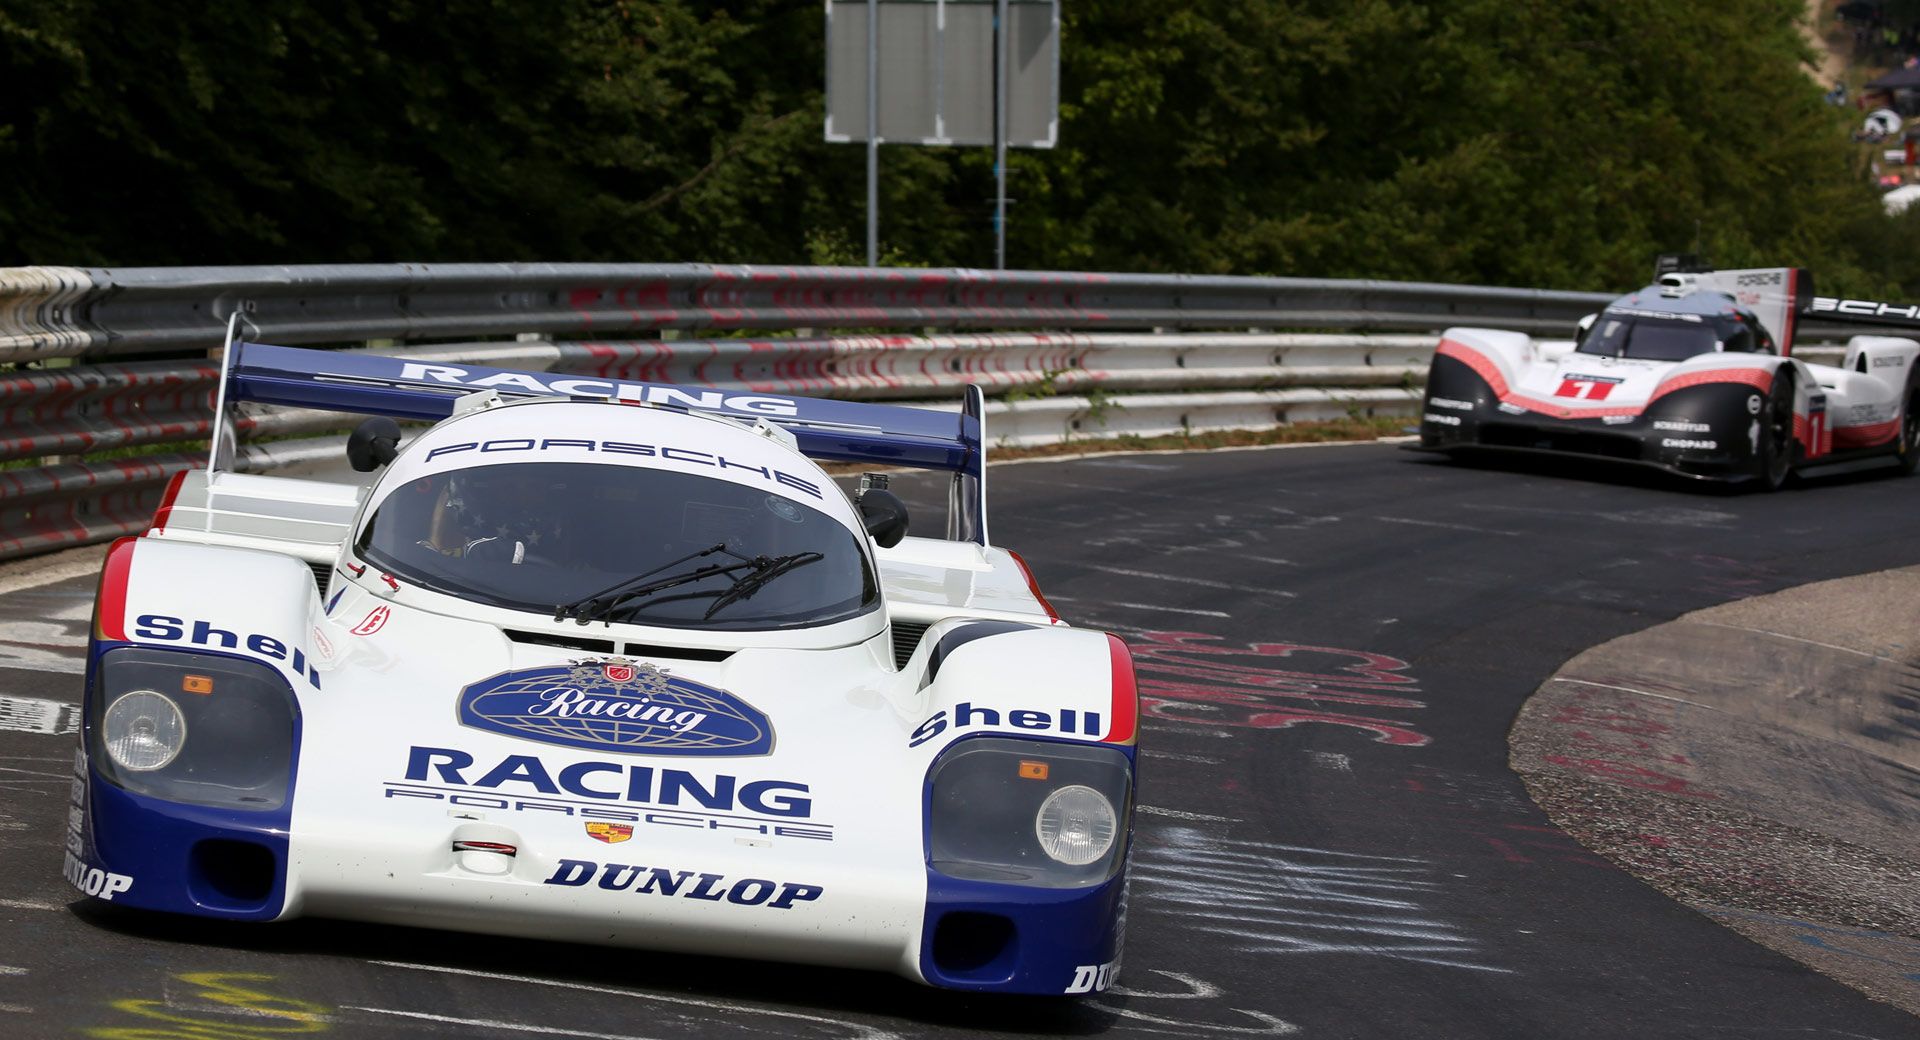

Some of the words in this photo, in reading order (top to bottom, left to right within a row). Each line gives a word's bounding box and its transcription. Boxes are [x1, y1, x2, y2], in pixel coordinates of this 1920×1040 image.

[399, 361, 798, 416] RACING
[1572, 380, 1597, 399] 1
[1653, 420, 1711, 434] SCHAEFFLER
[1661, 437, 1718, 450] CHOPARD
[1811, 415, 1820, 456] 1
[423, 437, 824, 501] PORSCHE
[134, 613, 322, 691] Shell
[527, 687, 708, 733] Racing
[908, 702, 1101, 748] Shell
[403, 745, 813, 819] RACING
[384, 787, 834, 841] PORSCHE
[62, 853, 135, 901] DUNLOP
[543, 858, 825, 910] DUNLOP
